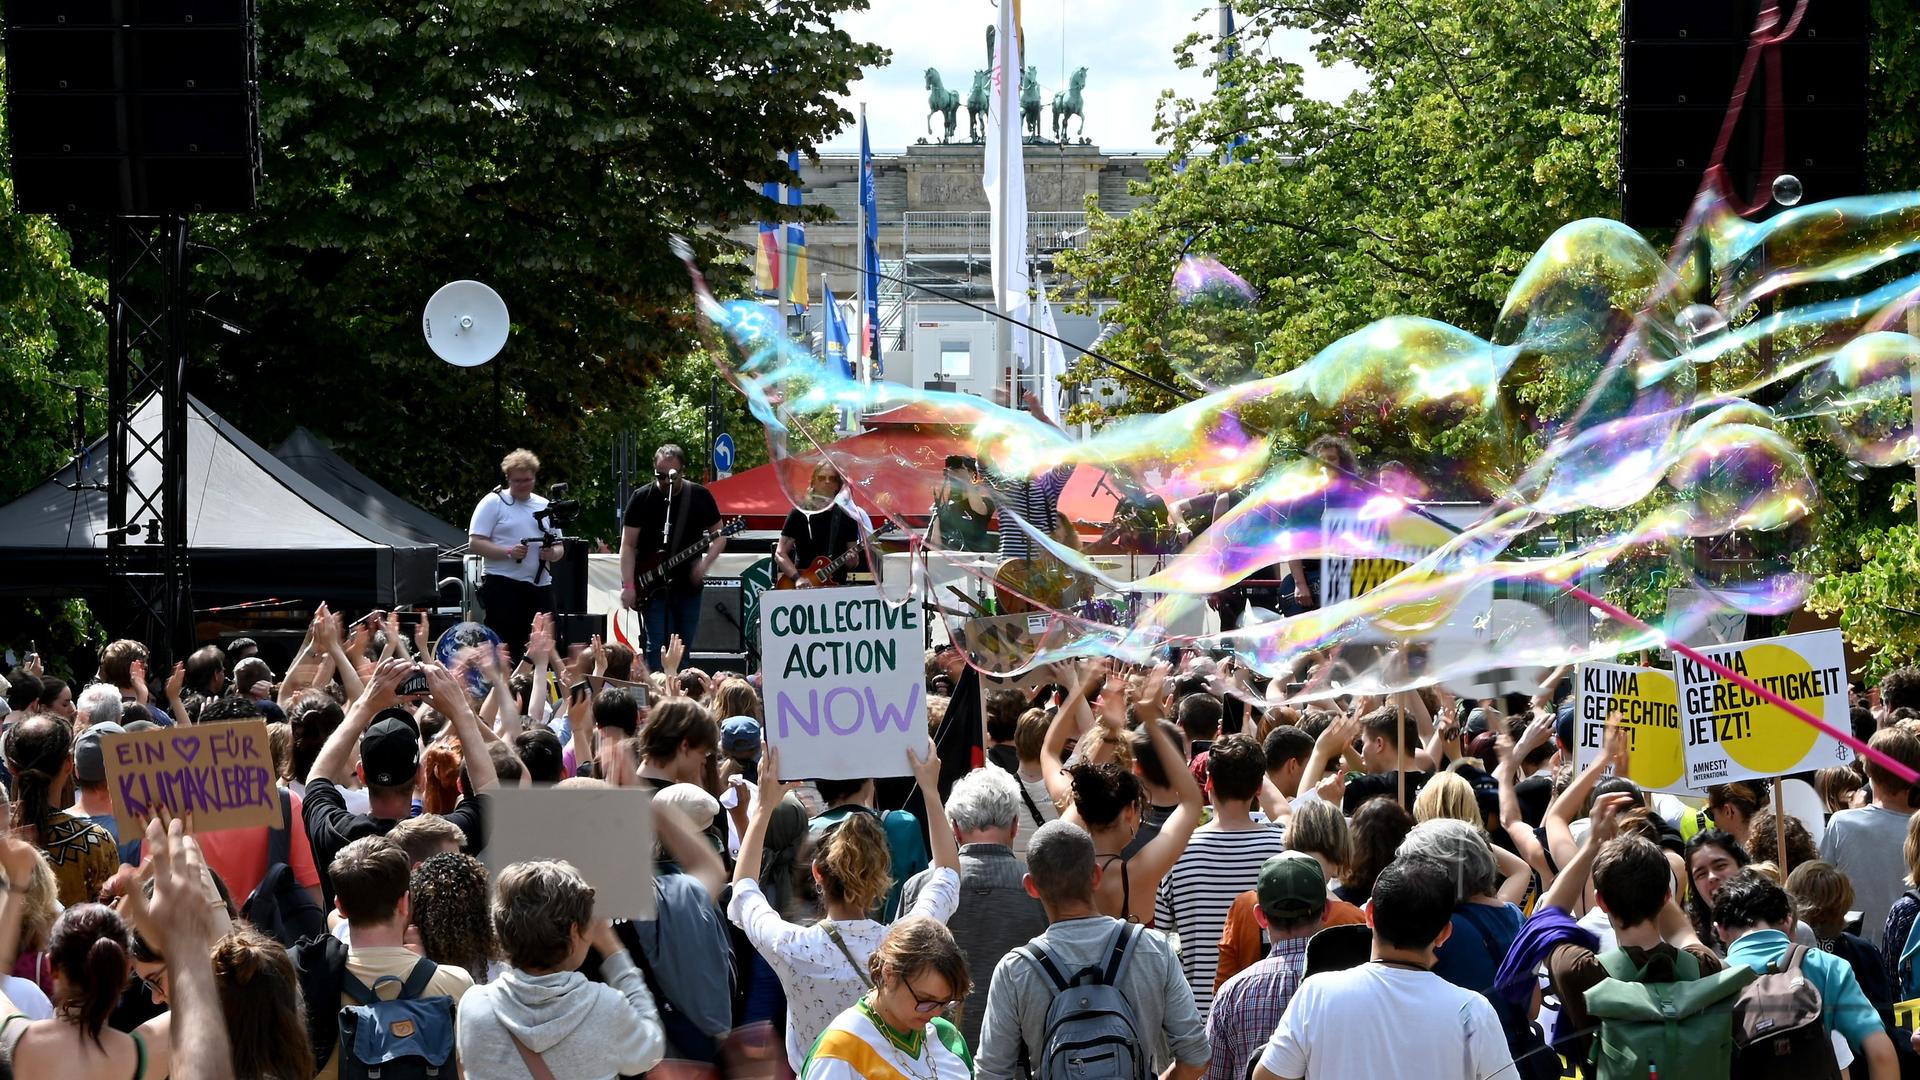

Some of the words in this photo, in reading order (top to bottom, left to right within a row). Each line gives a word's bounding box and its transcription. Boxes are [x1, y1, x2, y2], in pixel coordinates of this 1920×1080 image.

[770, 598, 917, 637] COLLECTIVE
[783, 639, 896, 679] ACTION
[1682, 650, 1748, 685] KLIMA
[1585, 667, 1639, 696] KLIMA
[1686, 667, 1840, 715] GERECHTIGKEIT
[777, 683, 920, 738] NOW
[1584, 695, 1679, 729] GERECHTIG
[1689, 711, 1751, 746] JETZT!
[116, 740, 165, 765] EIN
[210, 729, 260, 765] FÜR
[1693, 759, 1728, 774] AMNESTY
[1693, 770, 1729, 781] INTERNATIONAL
[118, 765, 273, 817] KLIMAKLEBER
